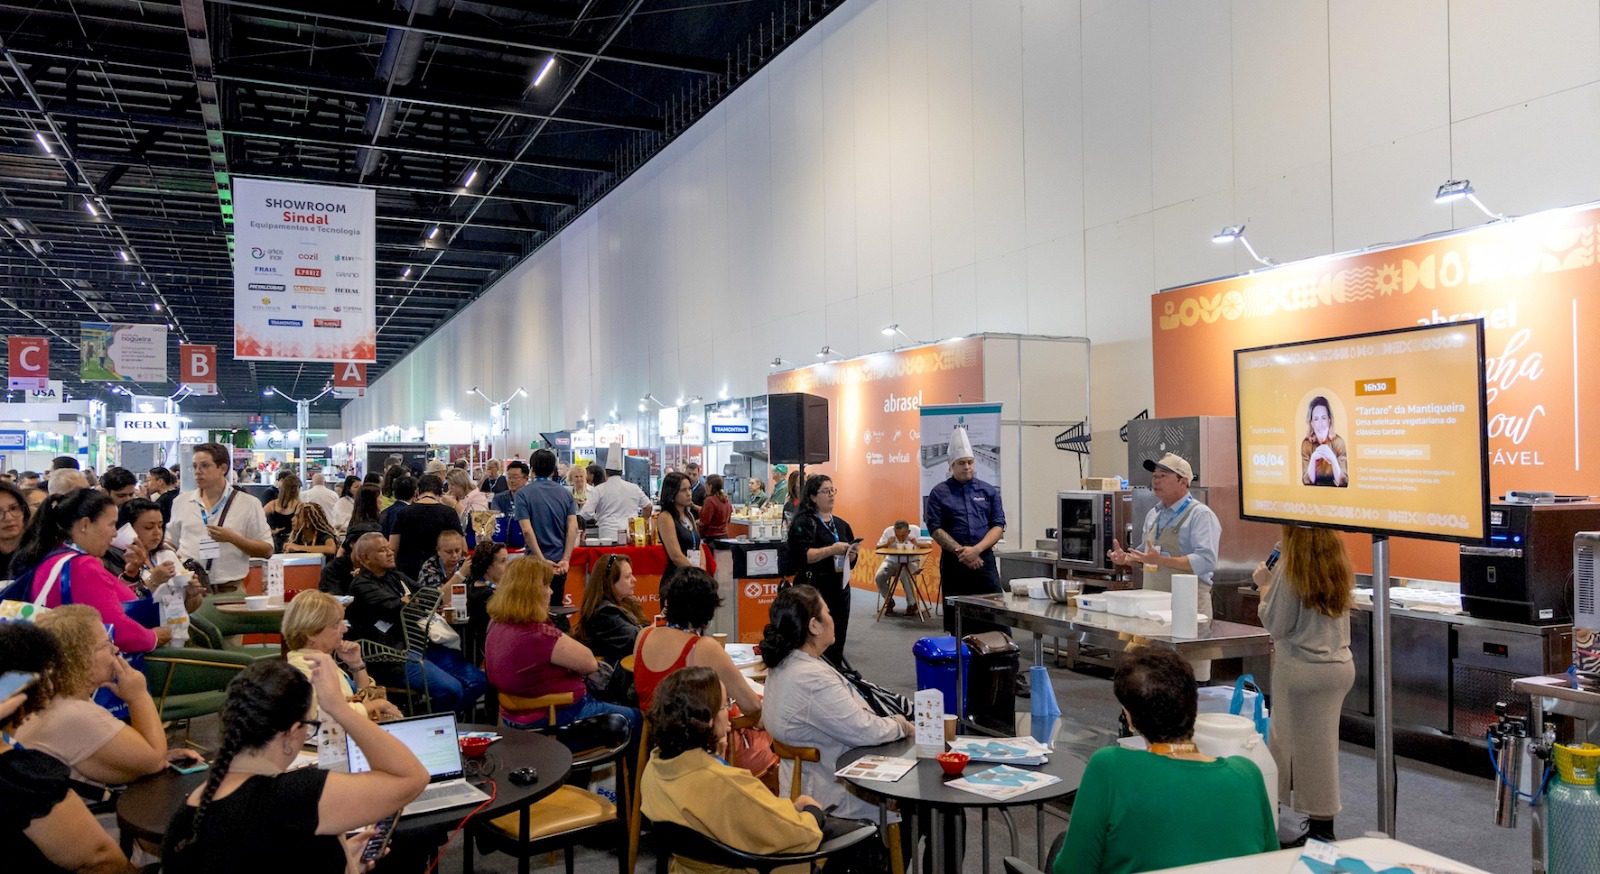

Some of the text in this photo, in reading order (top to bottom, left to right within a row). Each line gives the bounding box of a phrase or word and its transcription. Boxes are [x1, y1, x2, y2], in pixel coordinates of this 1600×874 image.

[265, 198, 346, 214] SHOWROOM
[283, 211, 329, 225] Sindal
[250, 221, 309, 232] Equipamentos
[317, 226, 360, 236] Tecnologia
[298, 253, 319, 261] cozil
[20, 345, 41, 372] C
[191, 353, 210, 377] B
[342, 361, 362, 381] A
[883, 390, 923, 413] abrasel
[1394, 404, 1406, 415] da
[1407, 402, 1465, 415] Mantiqueira
[124, 420, 171, 429] REBAL
[1252, 453, 1284, 467] 08/04
[1489, 448, 1545, 466] ÁVEL
[763, 583, 778, 594] TR
